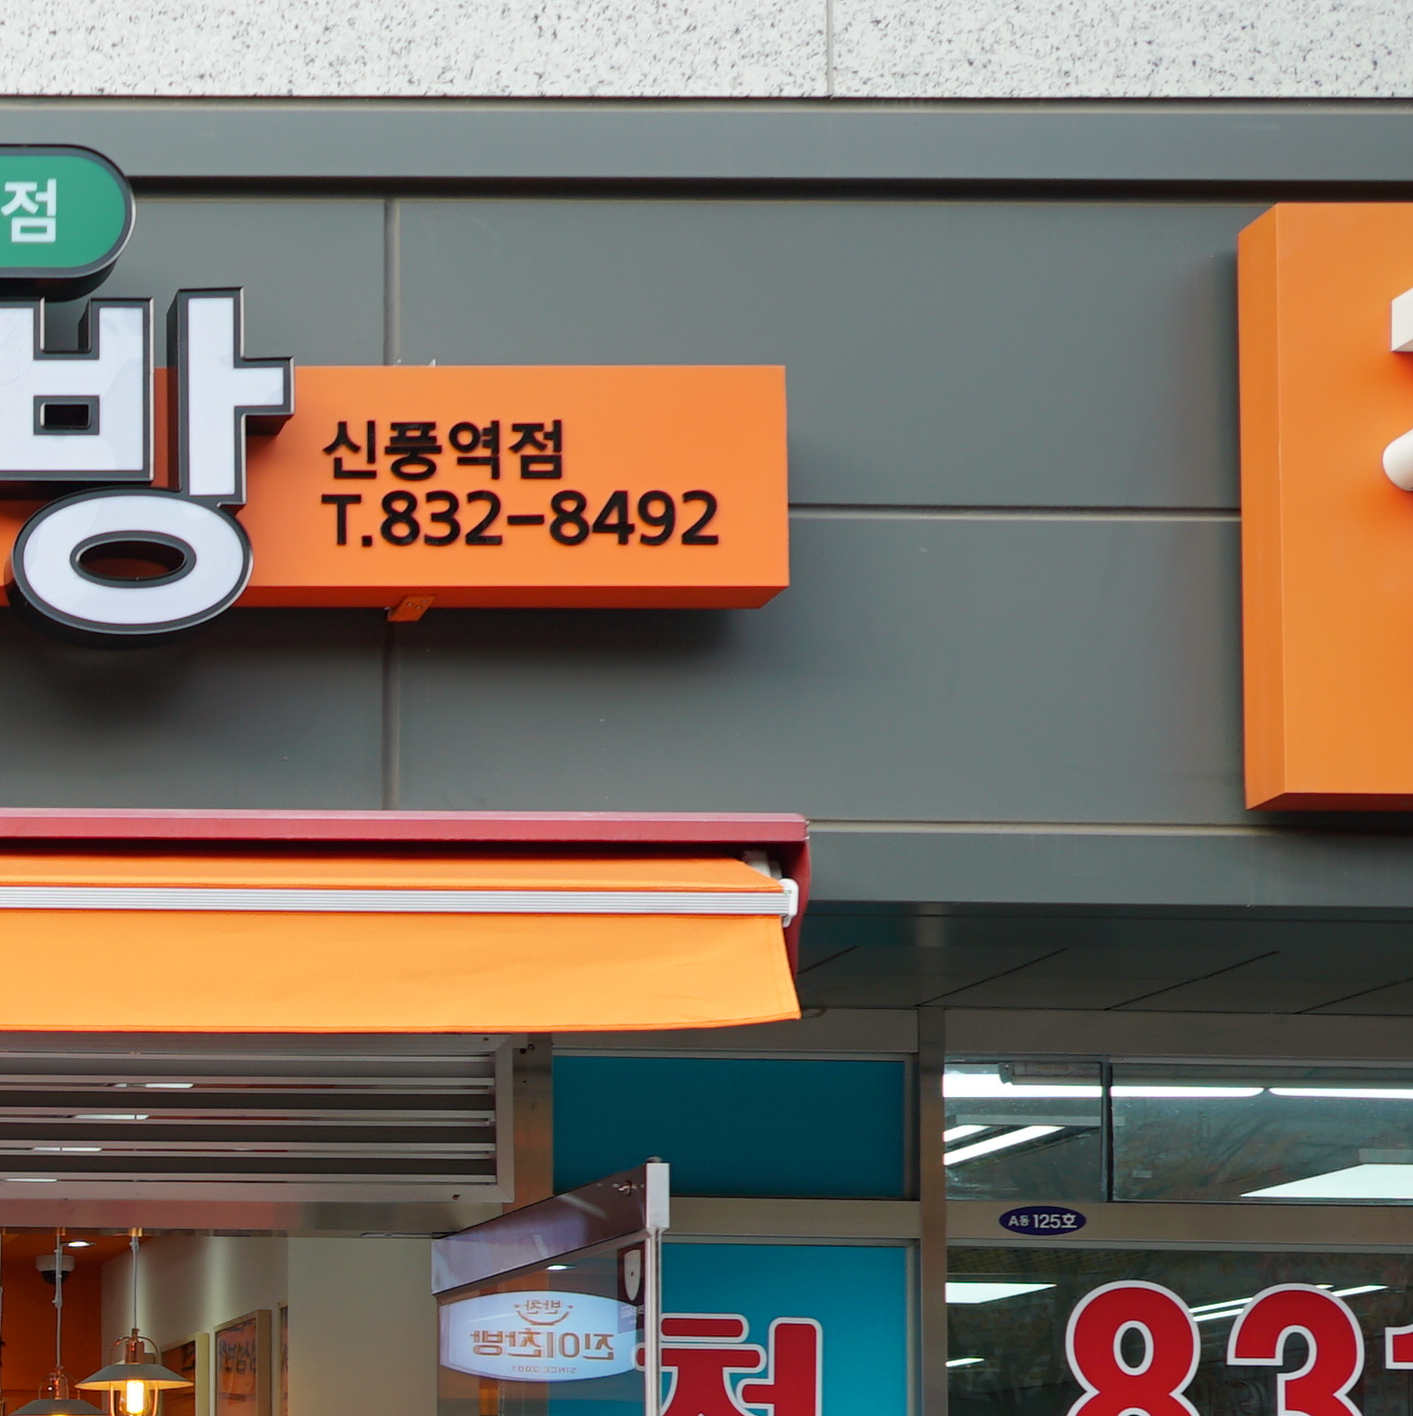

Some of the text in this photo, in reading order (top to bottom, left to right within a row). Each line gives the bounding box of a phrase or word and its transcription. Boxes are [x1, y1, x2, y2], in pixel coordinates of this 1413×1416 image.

[323, 419, 566, 481] 신풍역점
[321, 489, 721, 549] T.832-8492
[1033, 1213, 1077, 1231] 125호
